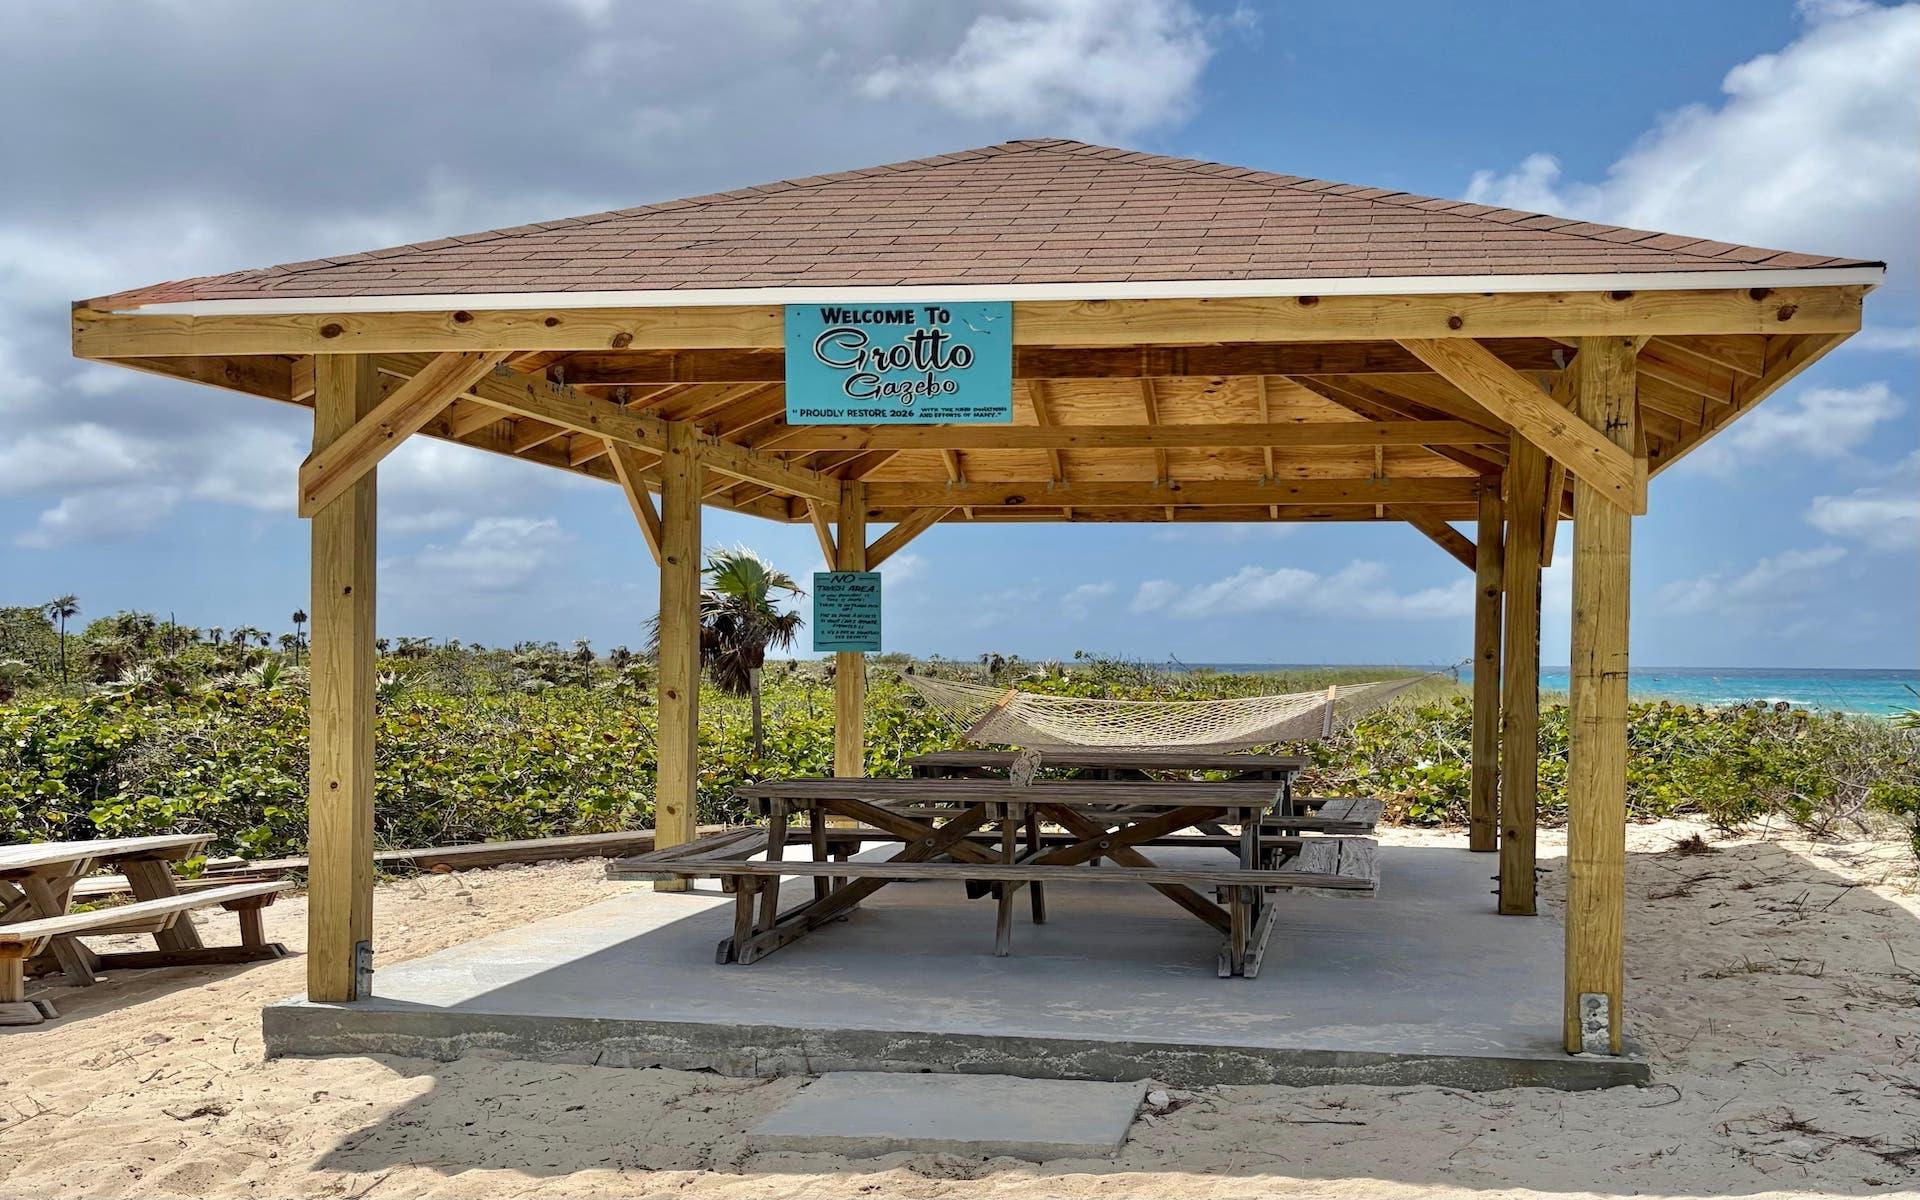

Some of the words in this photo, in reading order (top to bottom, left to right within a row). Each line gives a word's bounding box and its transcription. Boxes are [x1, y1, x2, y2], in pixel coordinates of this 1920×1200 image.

[820, 308, 915, 325] WELCOME
[924, 307, 951, 325] TO
[814, 326, 974, 373] Grotto
[844, 372, 957, 405] Gazebo
[847, 408, 888, 418] RESTORE
[889, 409, 915, 418] 2026
[830, 574, 856, 584] NO
